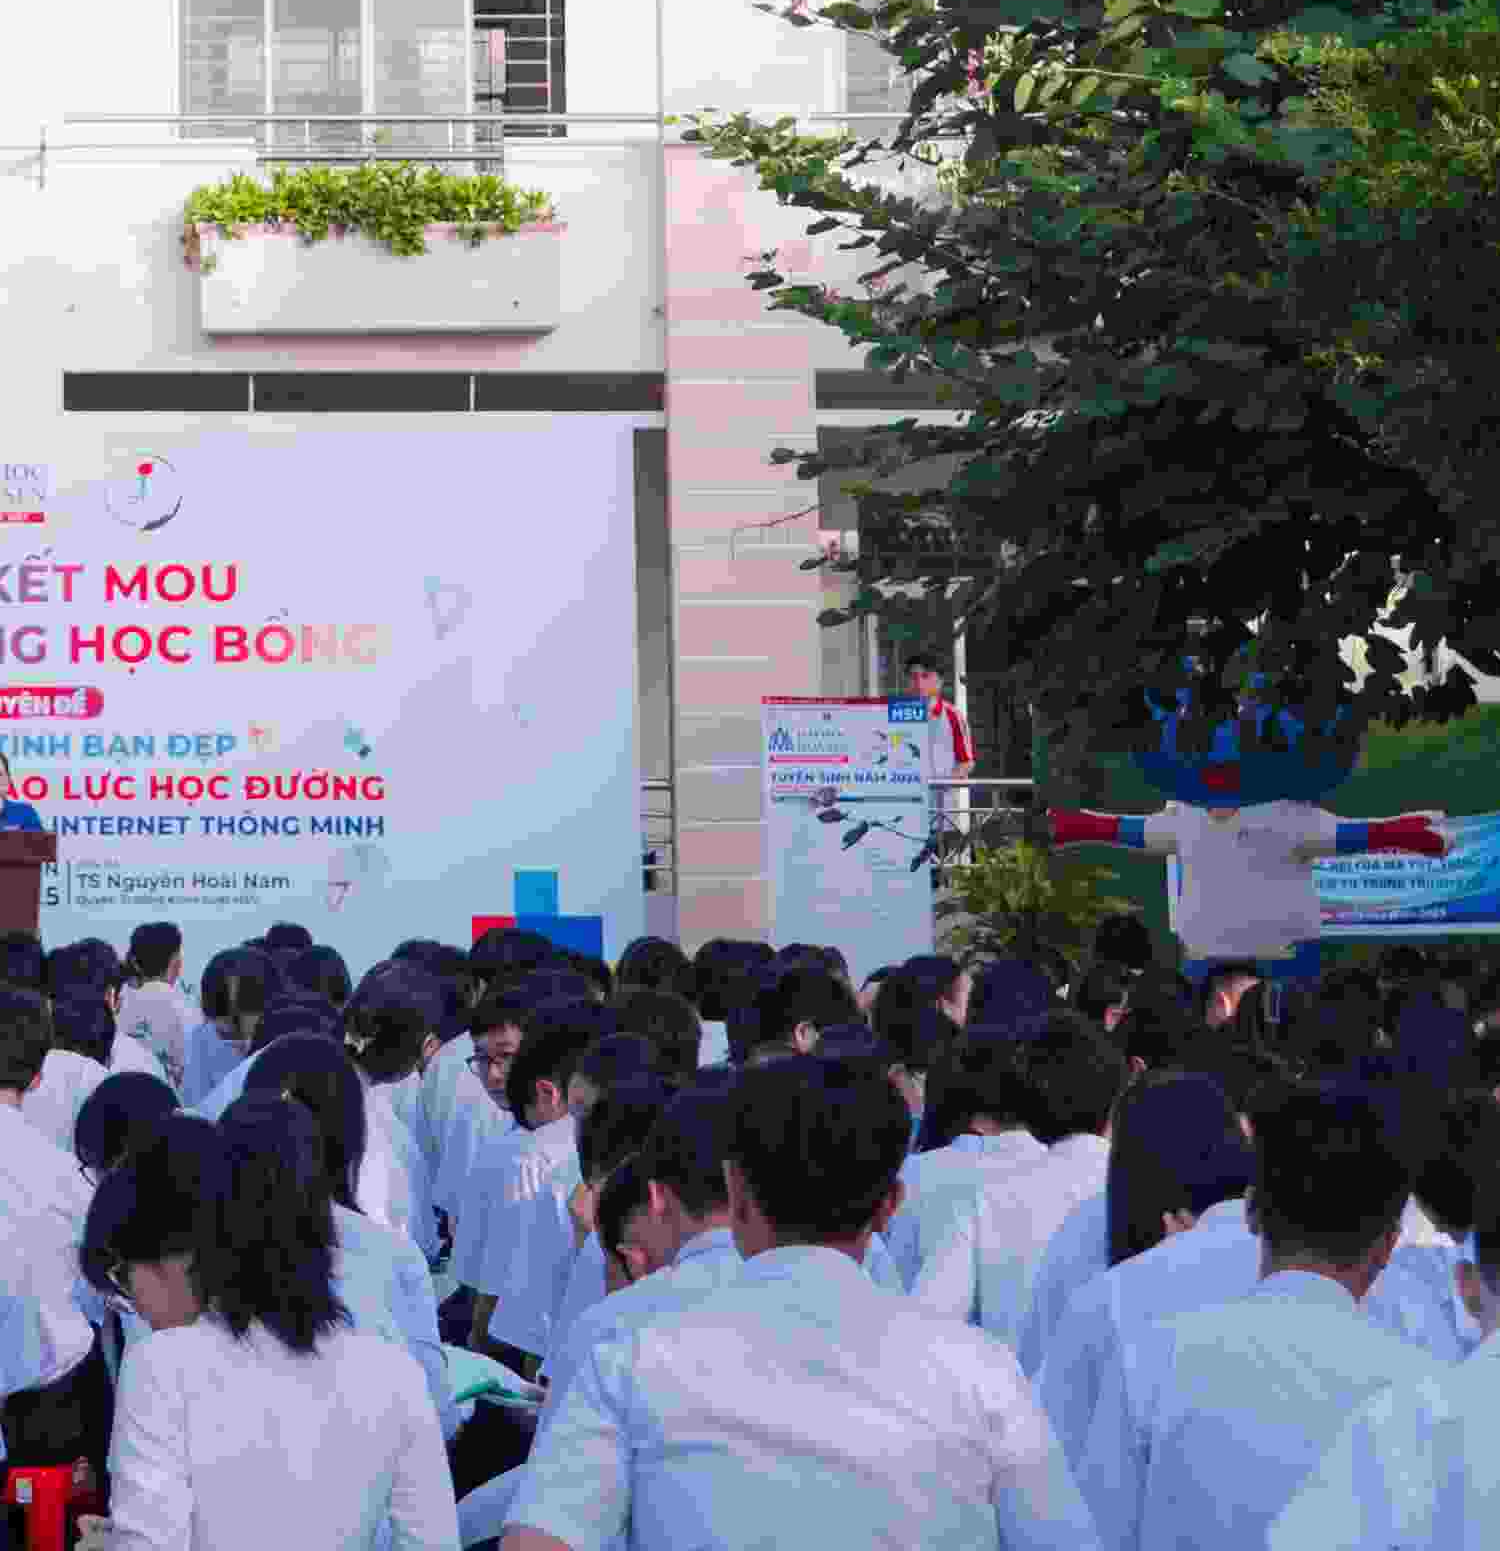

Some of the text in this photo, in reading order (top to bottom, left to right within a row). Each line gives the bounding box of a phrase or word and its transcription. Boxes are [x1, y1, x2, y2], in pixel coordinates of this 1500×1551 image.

[104, 564, 236, 603] MOU
[69, 625, 192, 678] HỌC
[891, 707, 924, 720] HSU
[150, 775, 230, 806] HỌC
[201, 808, 301, 836] THÔNG
[311, 815, 385, 836] MINH
